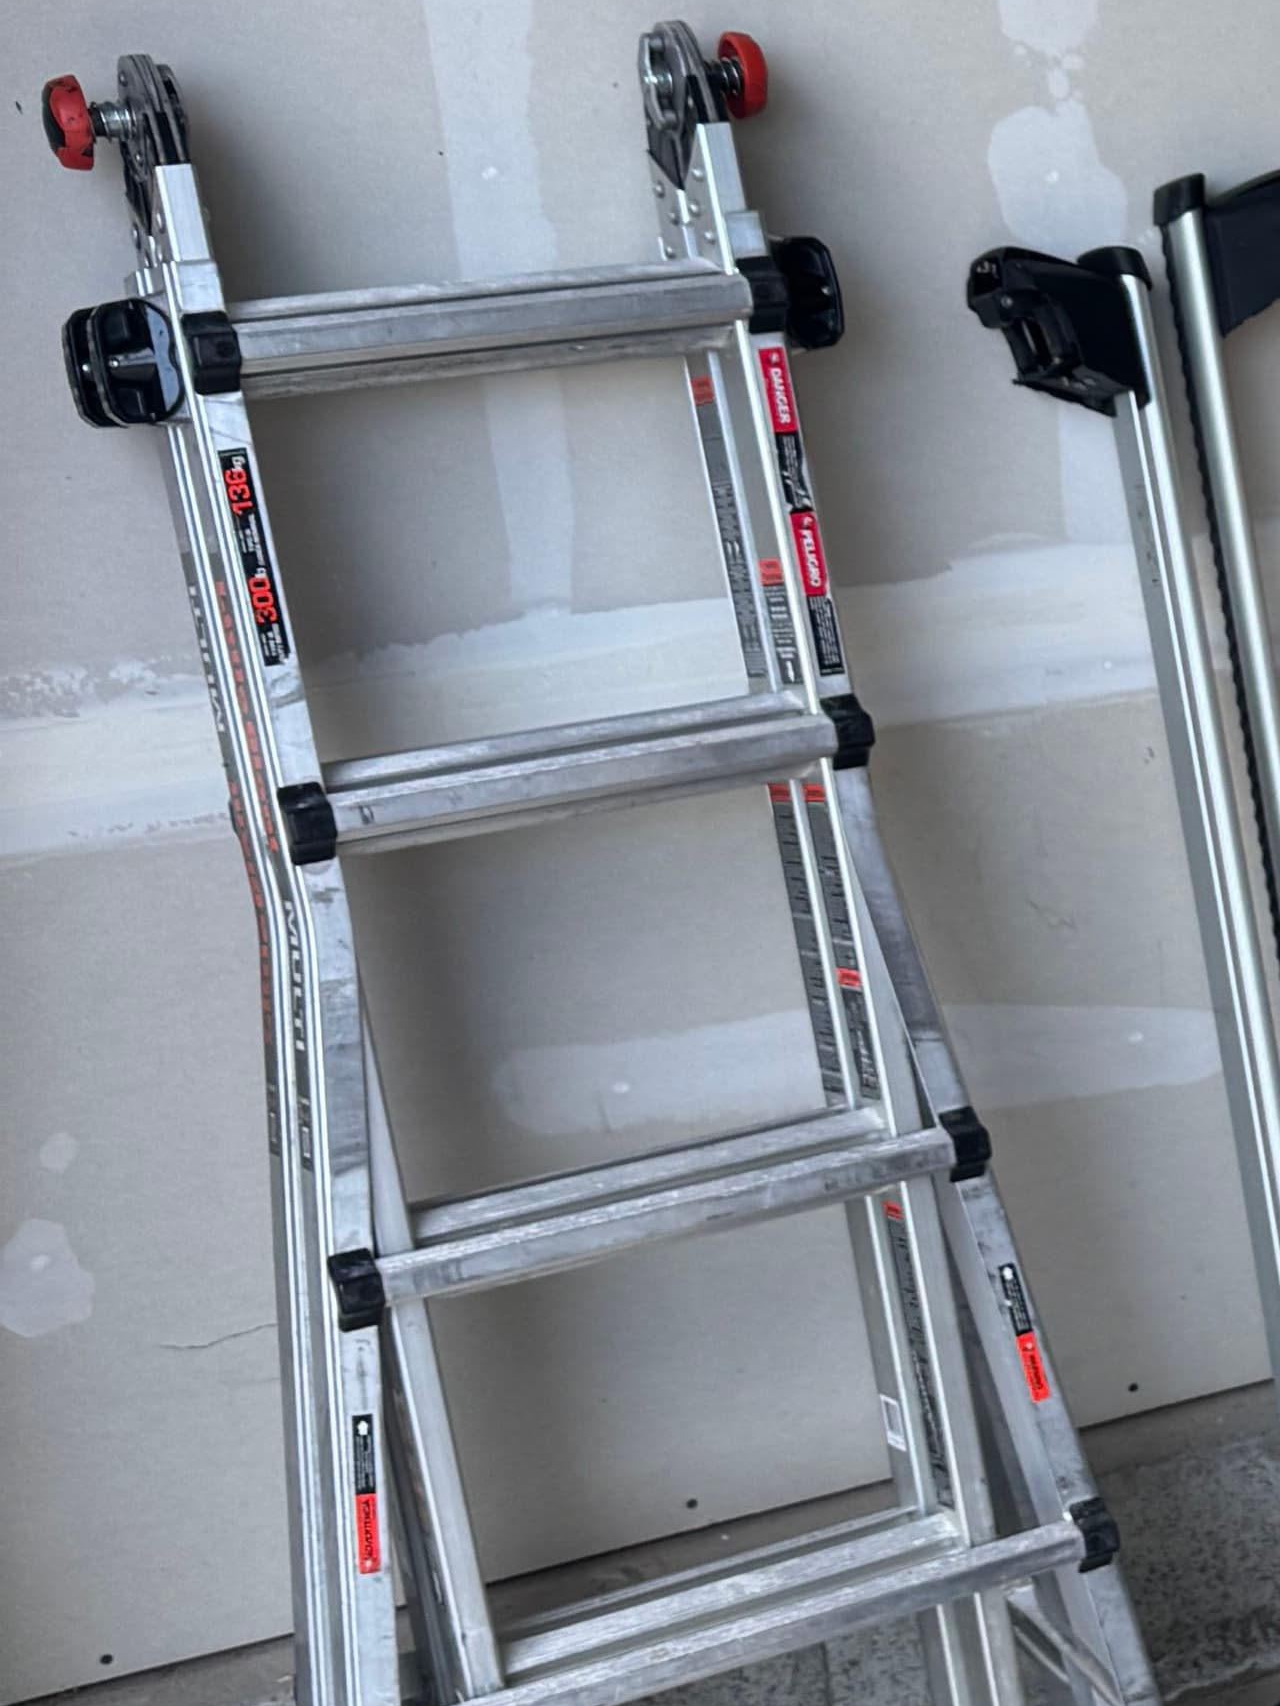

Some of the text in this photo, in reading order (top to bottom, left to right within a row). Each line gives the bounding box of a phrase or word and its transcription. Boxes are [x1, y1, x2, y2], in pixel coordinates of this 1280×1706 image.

[769, 366, 792, 425] DANGER
[801, 528, 823, 588] PELIGRO
[283, 900, 306, 1052] MULTI
